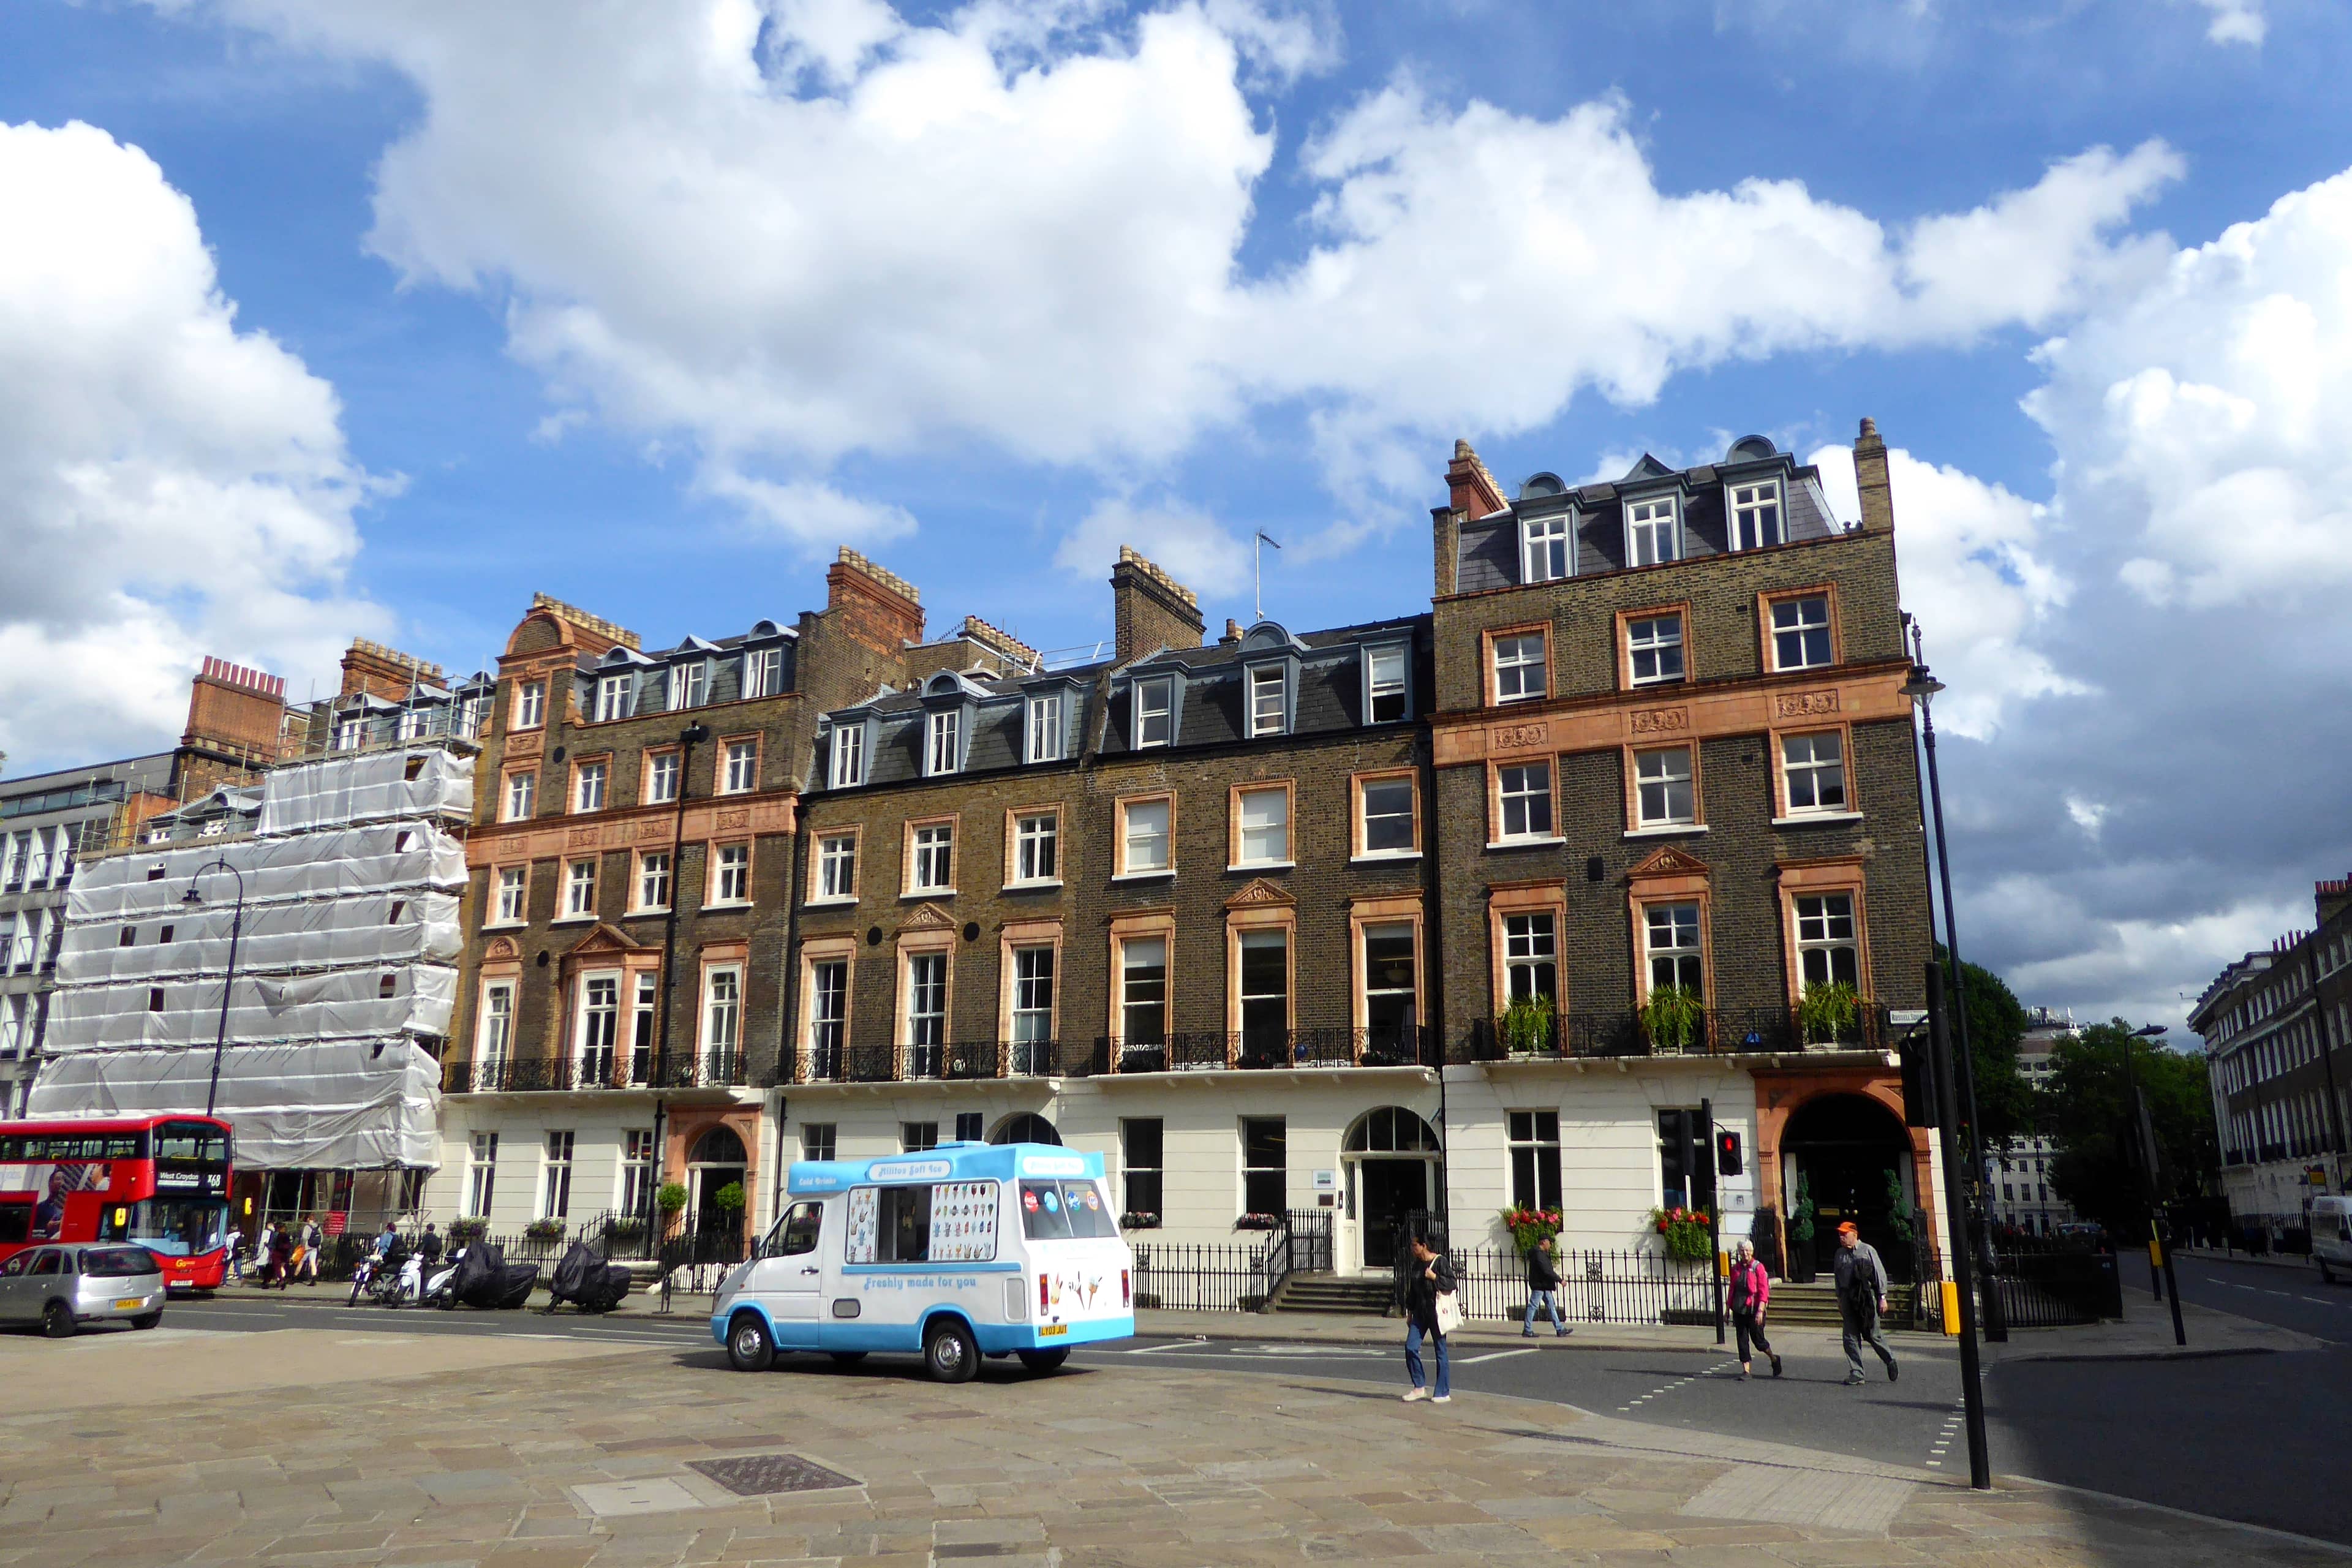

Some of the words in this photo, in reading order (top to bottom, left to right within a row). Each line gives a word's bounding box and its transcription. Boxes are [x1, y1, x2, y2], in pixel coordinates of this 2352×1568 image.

[176, 1172, 198, 1182] Croydon
[864, 1276, 903, 1291] Freshly
[907, 1276, 934, 1287] made
[938, 1276, 953, 1287] for
[956, 1277, 976, 1290] you
[1057, 1324, 1068, 1334] JUT
